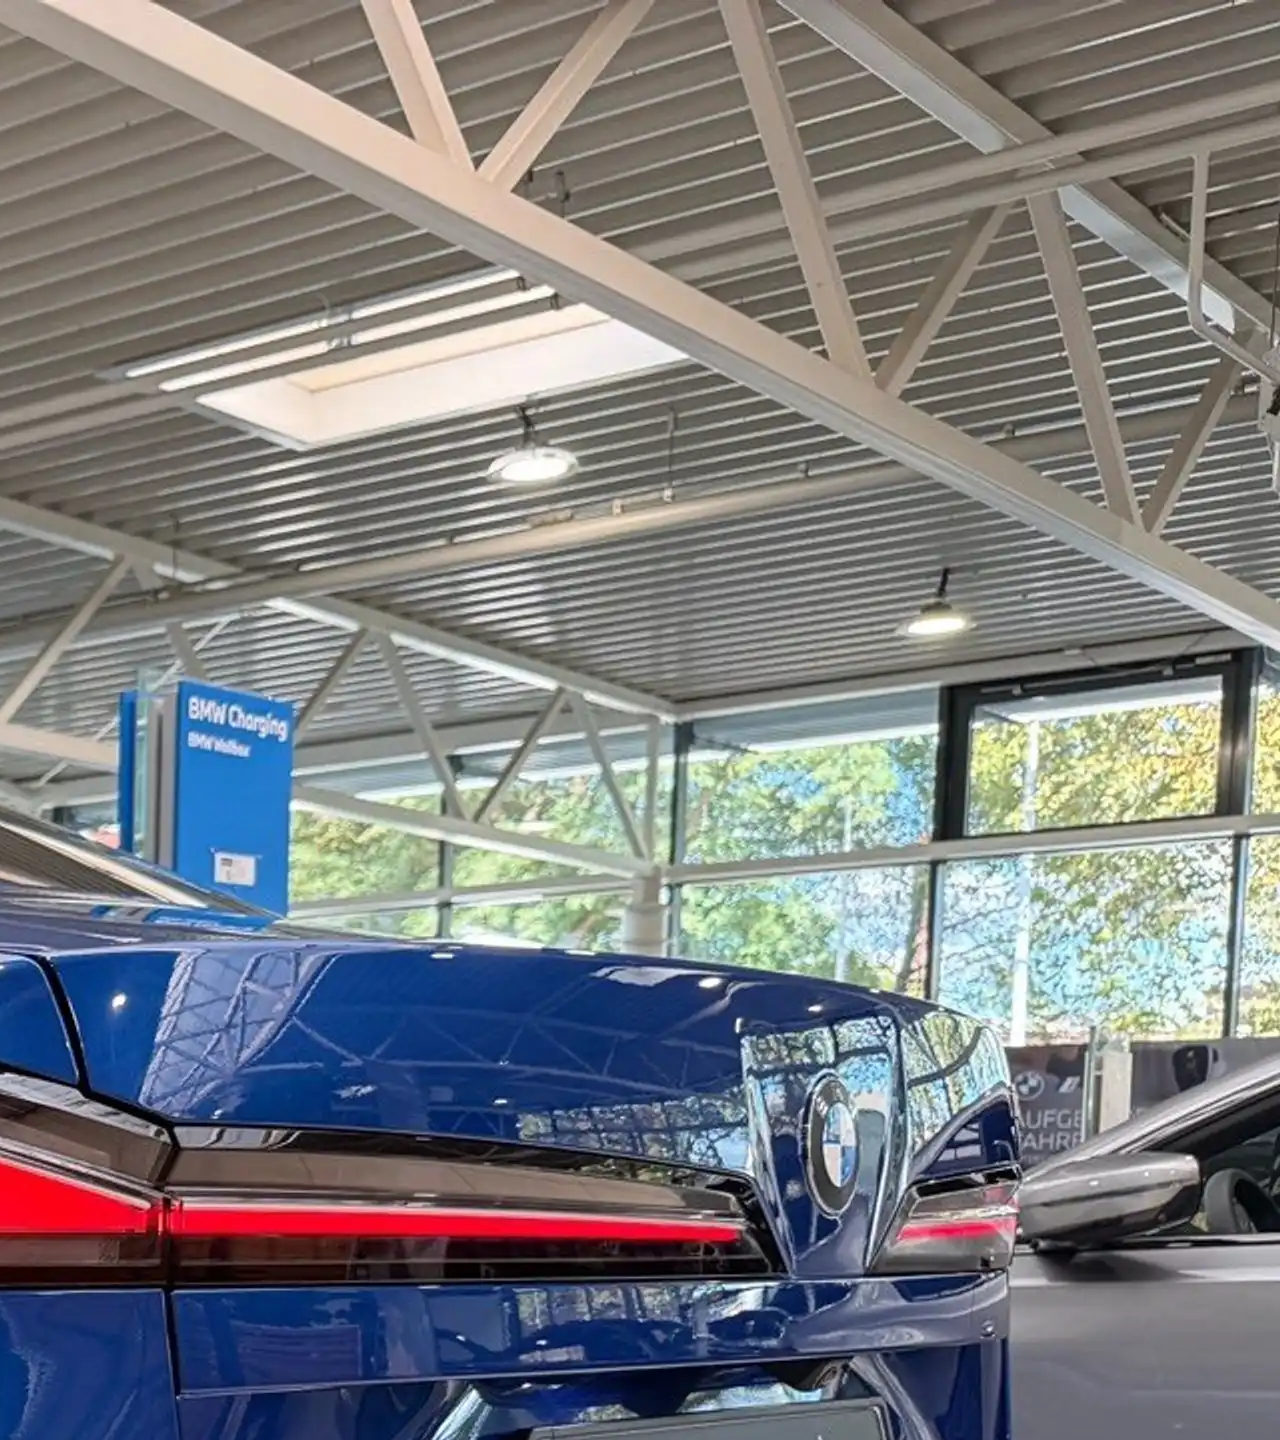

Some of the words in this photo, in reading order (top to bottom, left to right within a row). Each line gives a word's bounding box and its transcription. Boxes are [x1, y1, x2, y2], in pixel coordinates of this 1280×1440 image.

[188, 696, 227, 725] BMW
[228, 704, 289, 742] Charging
[188, 731, 213, 751] BMW
